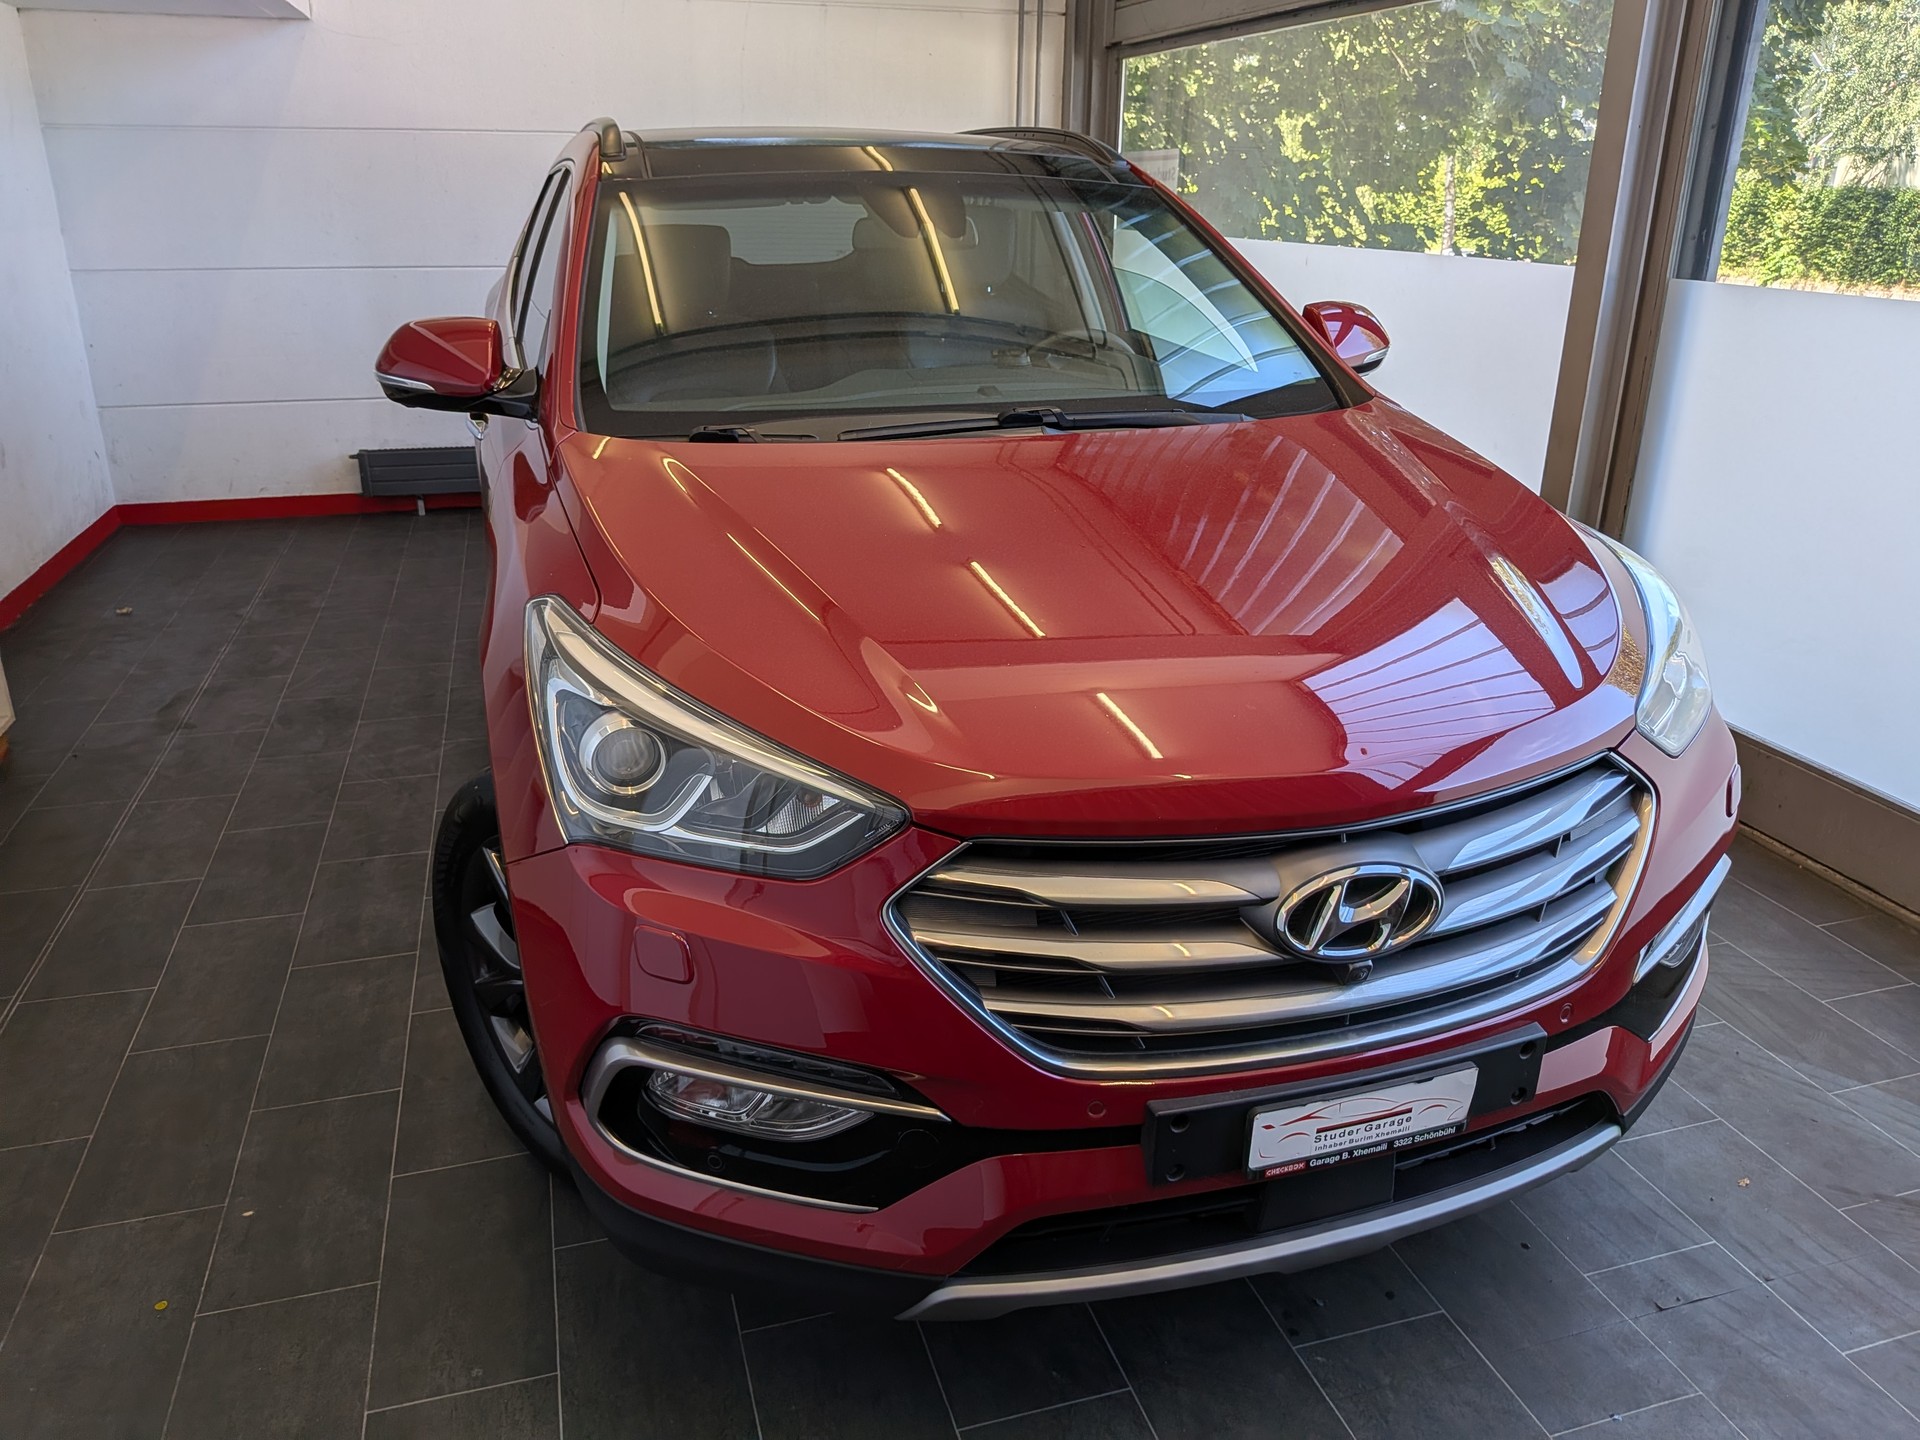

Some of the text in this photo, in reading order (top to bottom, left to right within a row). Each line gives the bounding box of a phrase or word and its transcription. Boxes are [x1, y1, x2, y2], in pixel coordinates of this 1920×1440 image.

[1314, 1116, 1412, 1144] Studer Garage
[1309, 1155, 1340, 1167] Garage
[1342, 1152, 1351, 1160] B.
[1393, 1136, 1413, 1148] 3322
[1414, 1126, 1456, 1143] Schönbühl
[1314, 1140, 1347, 1152] Inhaber
[1348, 1134, 1373, 1144] Burim
[1266, 1162, 1305, 1176] CHECKBOX
